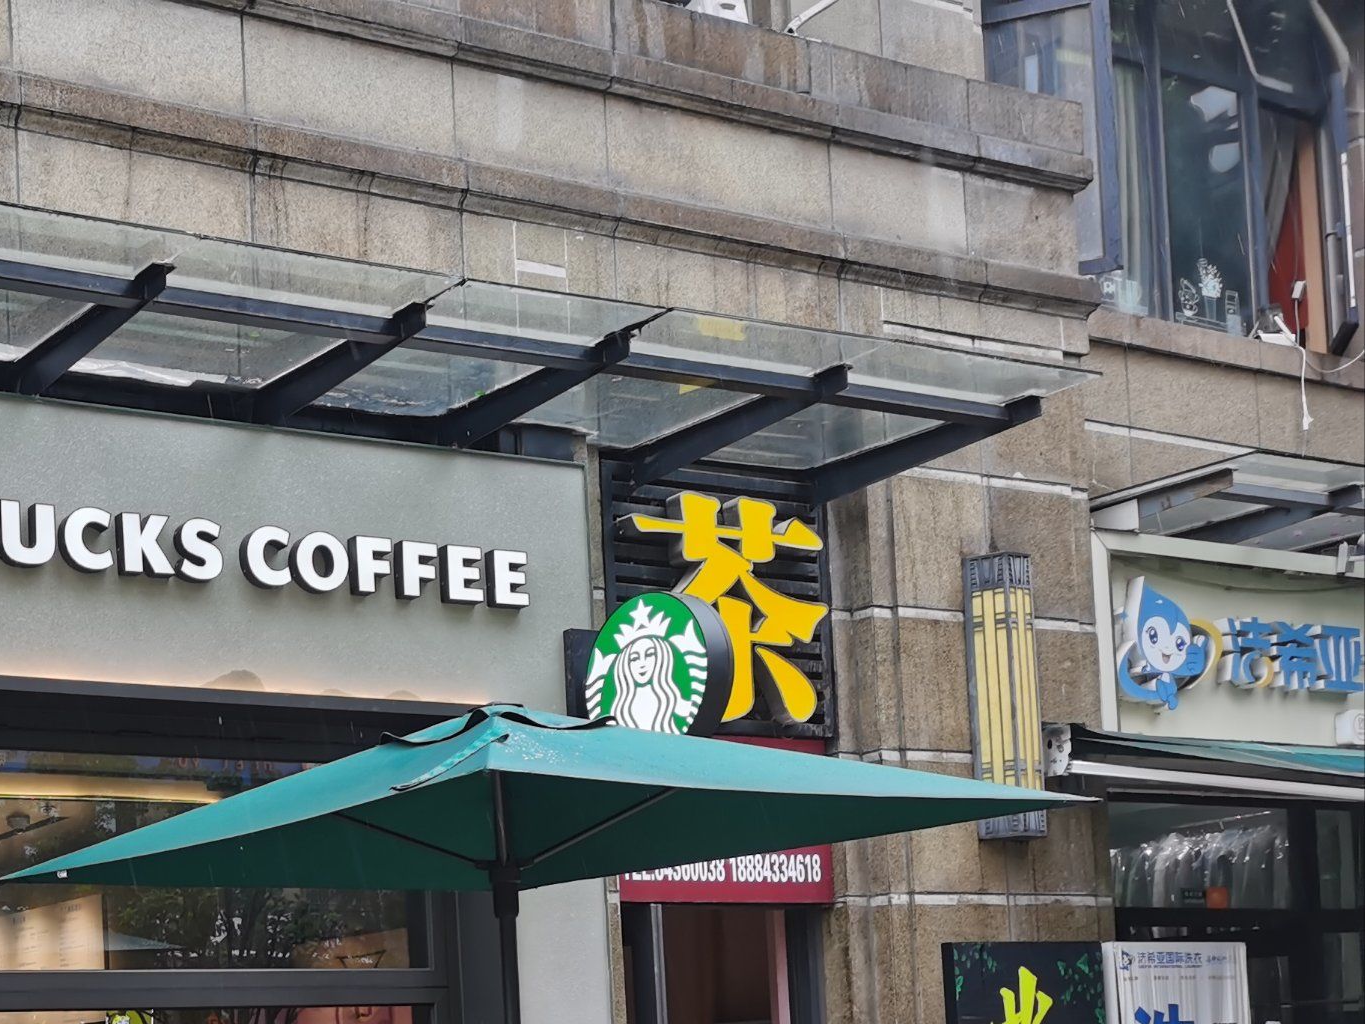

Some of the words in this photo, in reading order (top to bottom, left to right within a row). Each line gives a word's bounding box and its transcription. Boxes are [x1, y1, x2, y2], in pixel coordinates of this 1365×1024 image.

[239, 525, 531, 610] COFFEE
[630, 490, 830, 724] 茶
[729, 853, 822, 883] 18884334618
